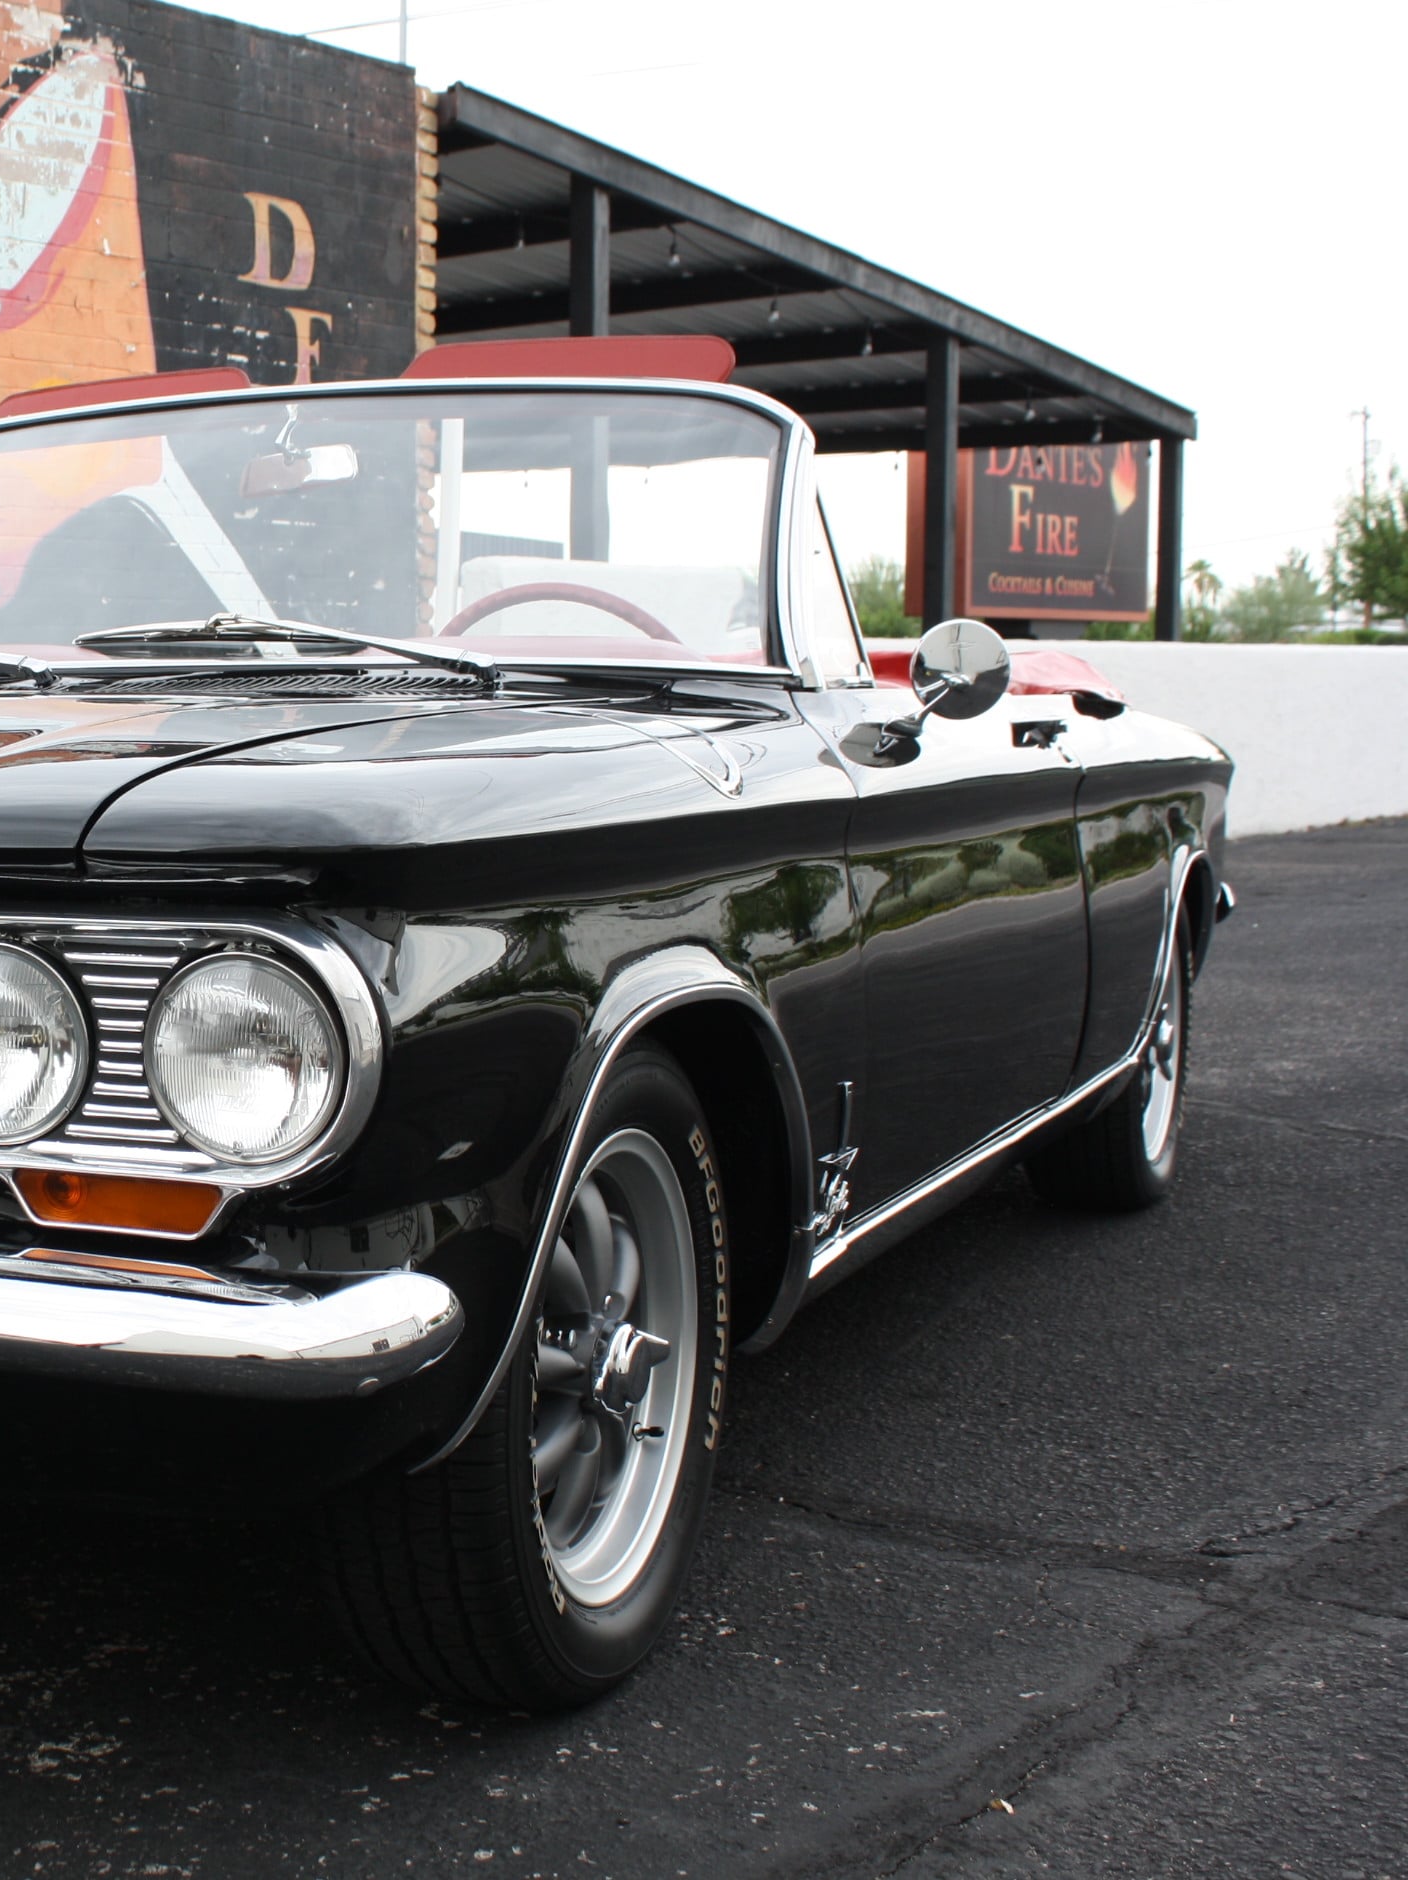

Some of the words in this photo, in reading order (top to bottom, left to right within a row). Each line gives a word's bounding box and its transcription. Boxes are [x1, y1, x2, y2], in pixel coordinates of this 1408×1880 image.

[237, 192, 315, 290] D
[285, 307, 332, 385] F
[1009, 484, 1080, 557] FIRE
[688, 1127, 728, 1450] BFGoodrich
